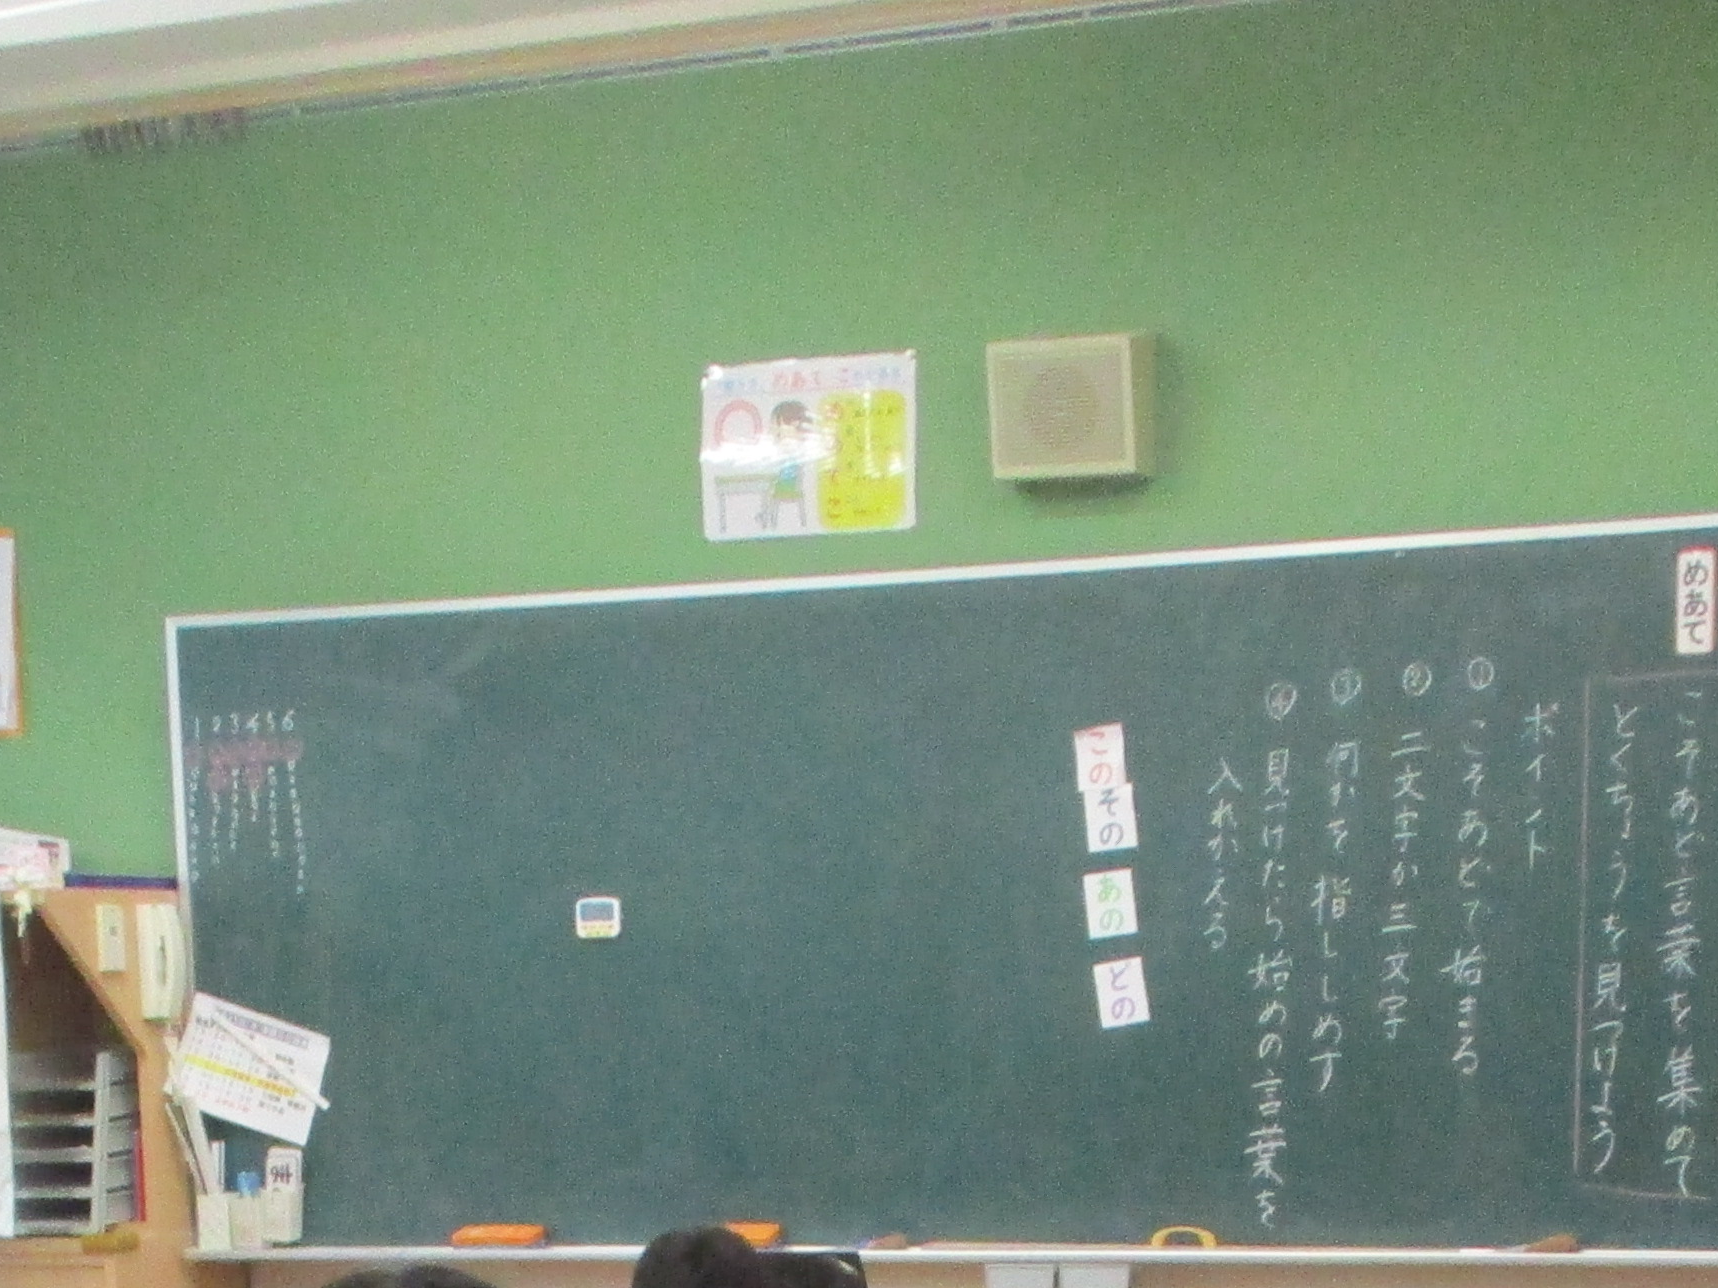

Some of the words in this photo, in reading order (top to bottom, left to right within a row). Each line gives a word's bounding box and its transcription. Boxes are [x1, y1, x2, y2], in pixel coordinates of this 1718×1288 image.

[1683, 558, 1710, 645] めあて
[281, 709, 296, 732] 6
[1088, 730, 1114, 786] この
[1522, 702, 1560, 870] ポイント
[1097, 787, 1125, 847] その
[1097, 874, 1125, 932] あの
[1109, 962, 1137, 1022] どの
